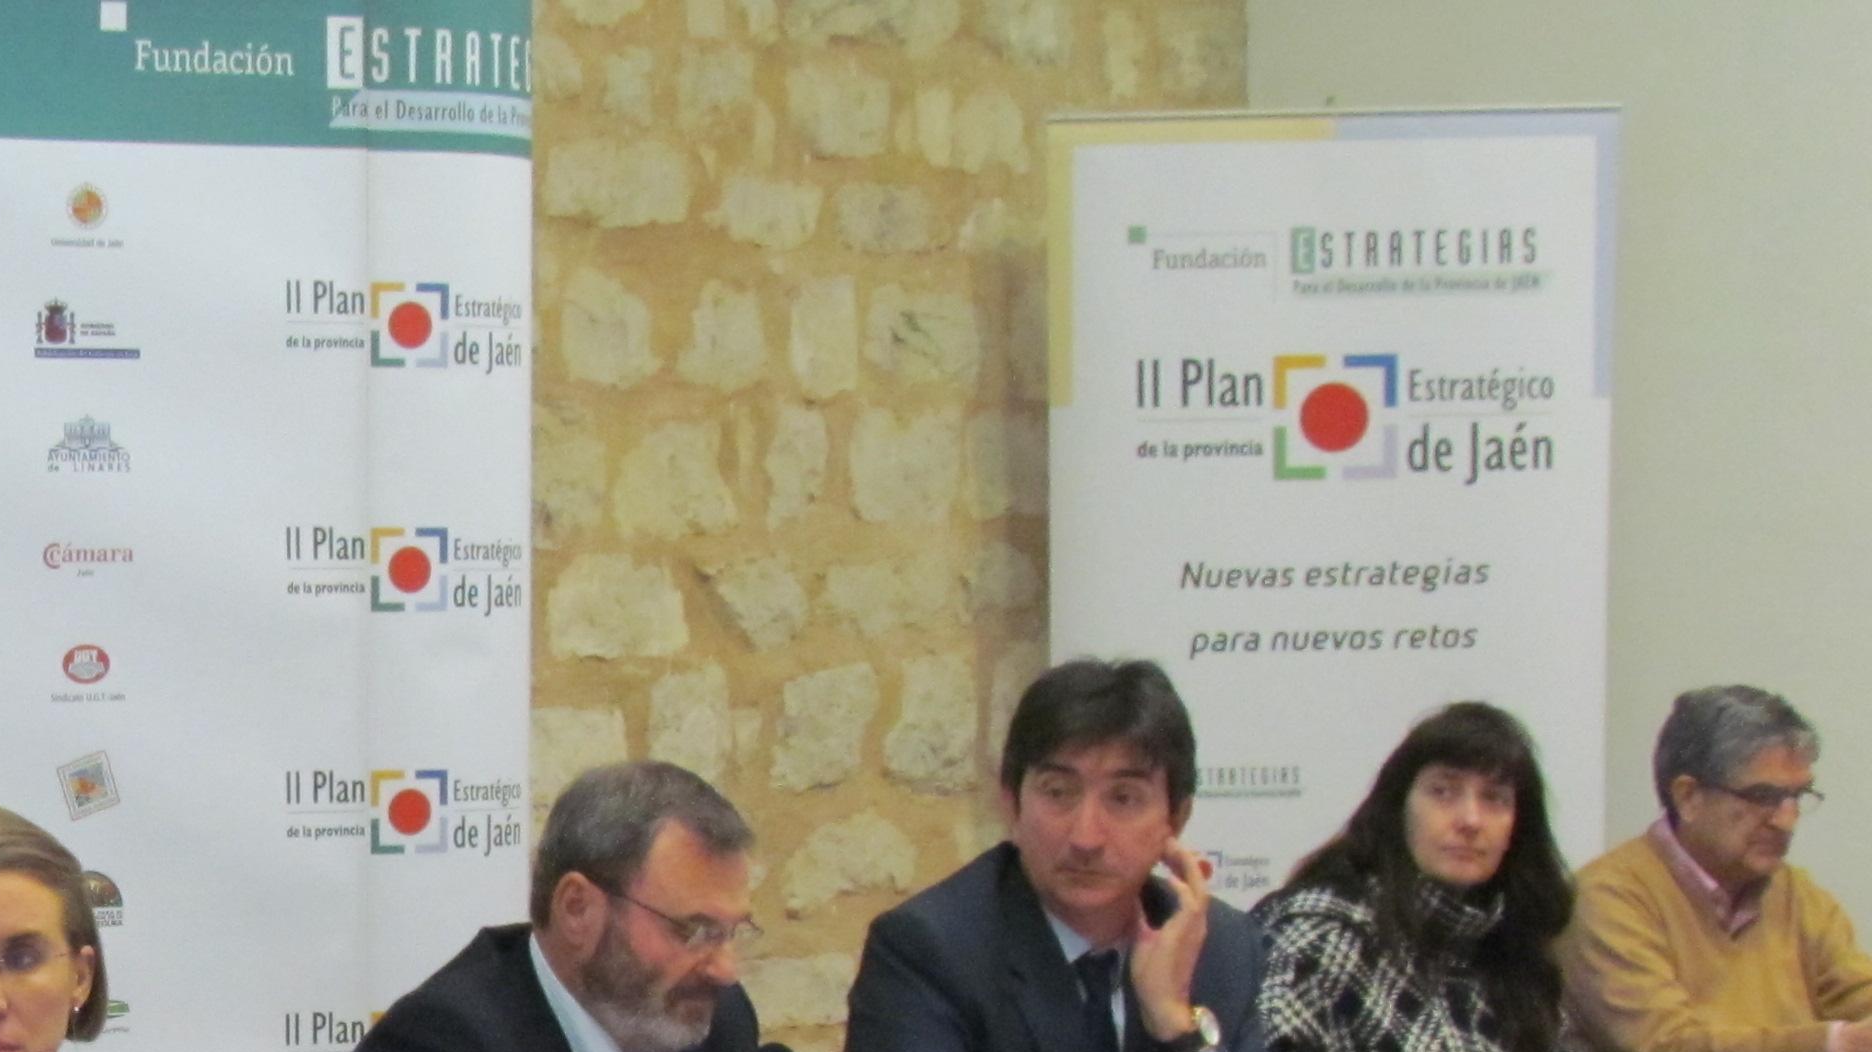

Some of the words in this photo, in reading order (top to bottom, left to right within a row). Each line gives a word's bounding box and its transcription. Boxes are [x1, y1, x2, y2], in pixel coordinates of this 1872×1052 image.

[134, 38, 296, 77] Fundación
[332, 95, 367, 118] Para
[375, 102, 389, 120] el
[396, 100, 474, 123] Desarrollo
[480, 106, 494, 123] de
[497, 106, 508, 125] la
[1151, 247, 1267, 271] Fundación
[1294, 227, 1538, 271] ESTRATEGIAS
[313, 280, 365, 315] Plan
[454, 294, 522, 326] Estratégico
[286, 336, 299, 349] de
[302, 335, 312, 349] la
[314, 336, 365, 352] provincia
[454, 331, 479, 365] de
[486, 331, 522, 375] Jaén
[1137, 359, 1161, 409] II
[1181, 358, 1263, 409] Plan
[1408, 369, 1555, 411] Estratégico
[47, 452, 131, 462] AYUNTAMIENTO
[73, 462, 131, 473] LINARES
[1137, 440, 1158, 458] de
[1163, 440, 1178, 458] la
[1183, 438, 1263, 461] provincia
[1408, 423, 1453, 472] de
[1464, 419, 1554, 485] Jaén
[313, 526, 365, 560] Plan
[453, 538, 522, 567] Estratégico
[1180, 562, 1294, 590] Nuevas
[1305, 558, 1490, 592] estrategias
[287, 581, 300, 594] de
[302, 581, 312, 594] la
[314, 581, 366, 597] provincia
[453, 574, 478, 608] de
[484, 574, 522, 617] Jaén
[1189, 631, 1260, 660] para
[1271, 628, 1384, 652] nuevos
[1393, 625, 1479, 650] retos
[313, 769, 366, 805] Plan
[453, 778, 522, 807] Estratégico
[286, 826, 300, 839] de
[302, 825, 312, 838] la
[314, 824, 366, 840] provincia
[453, 815, 479, 849] de
[484, 814, 522, 857] Jaén
[313, 1011, 365, 1044] Plan
